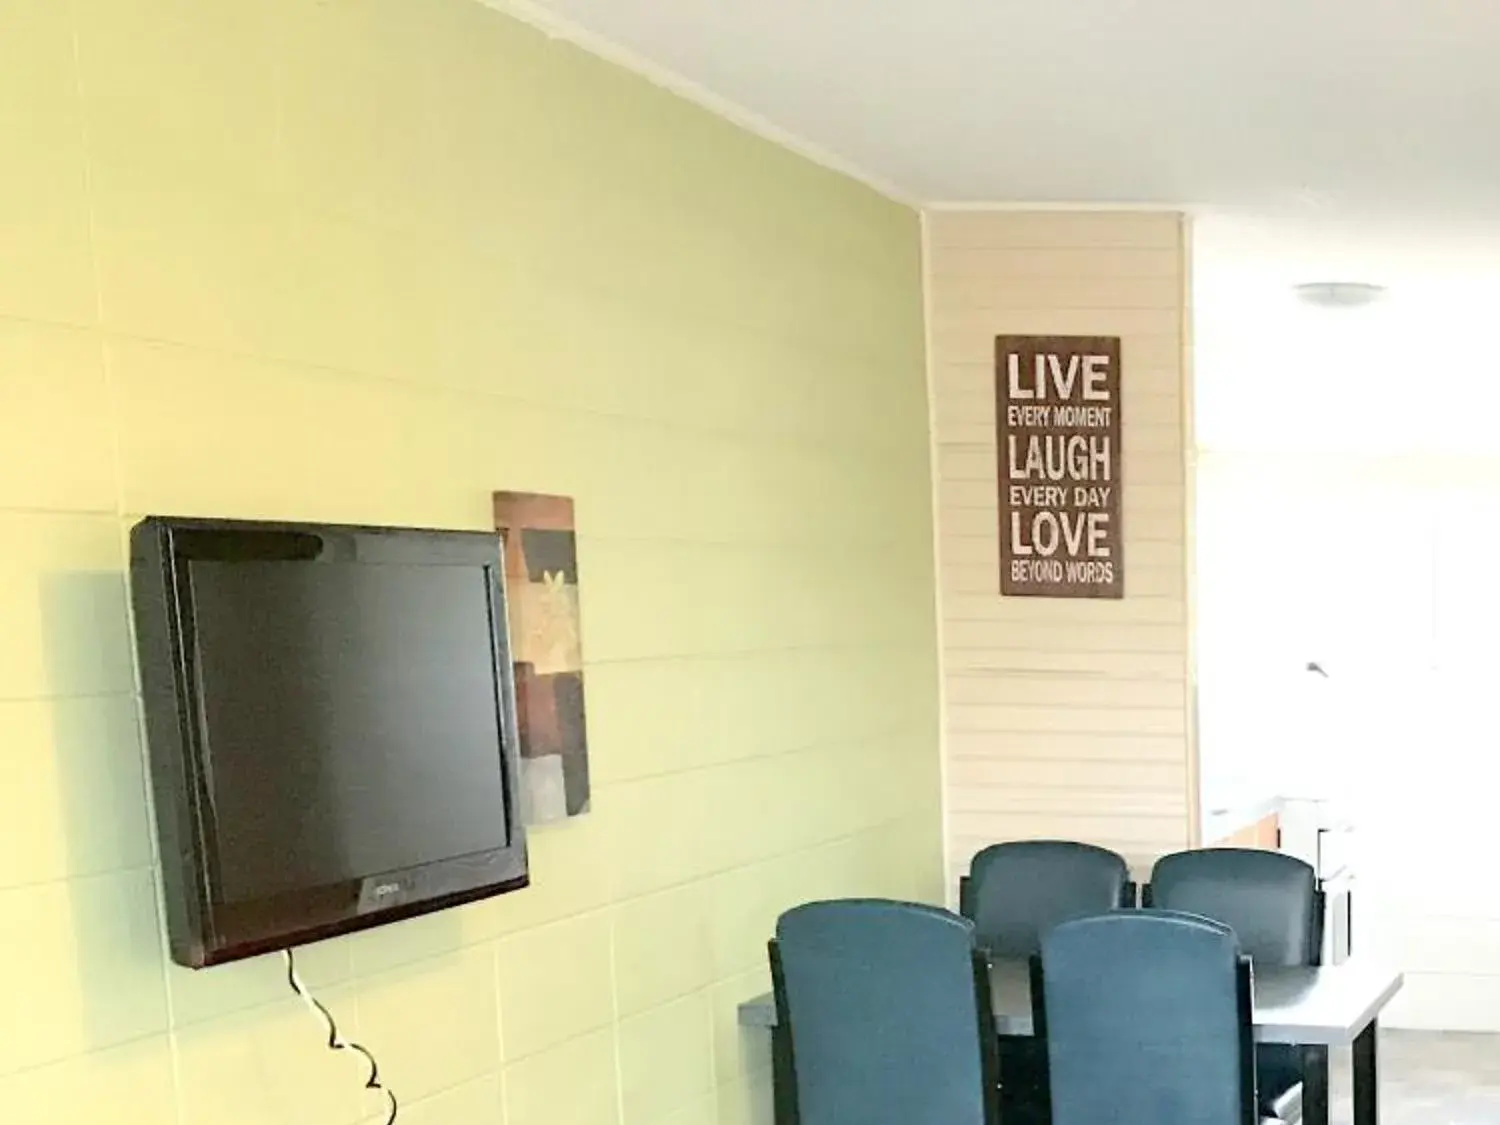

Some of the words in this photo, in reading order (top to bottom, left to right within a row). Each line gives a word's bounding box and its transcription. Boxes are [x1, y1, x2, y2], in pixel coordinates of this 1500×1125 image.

[1007, 354, 1110, 400] LIVE
[1007, 406, 1050, 427] EVERY
[1054, 406, 1112, 428] MOMENT
[1008, 435, 1111, 481] LAUGH
[1009, 485, 1068, 507] EVERY
[1074, 486, 1111, 507] DAY
[1011, 511, 1110, 557] LOVE
[1011, 560, 1062, 582] BEYOND
[1066, 561, 1113, 584] WORDS
